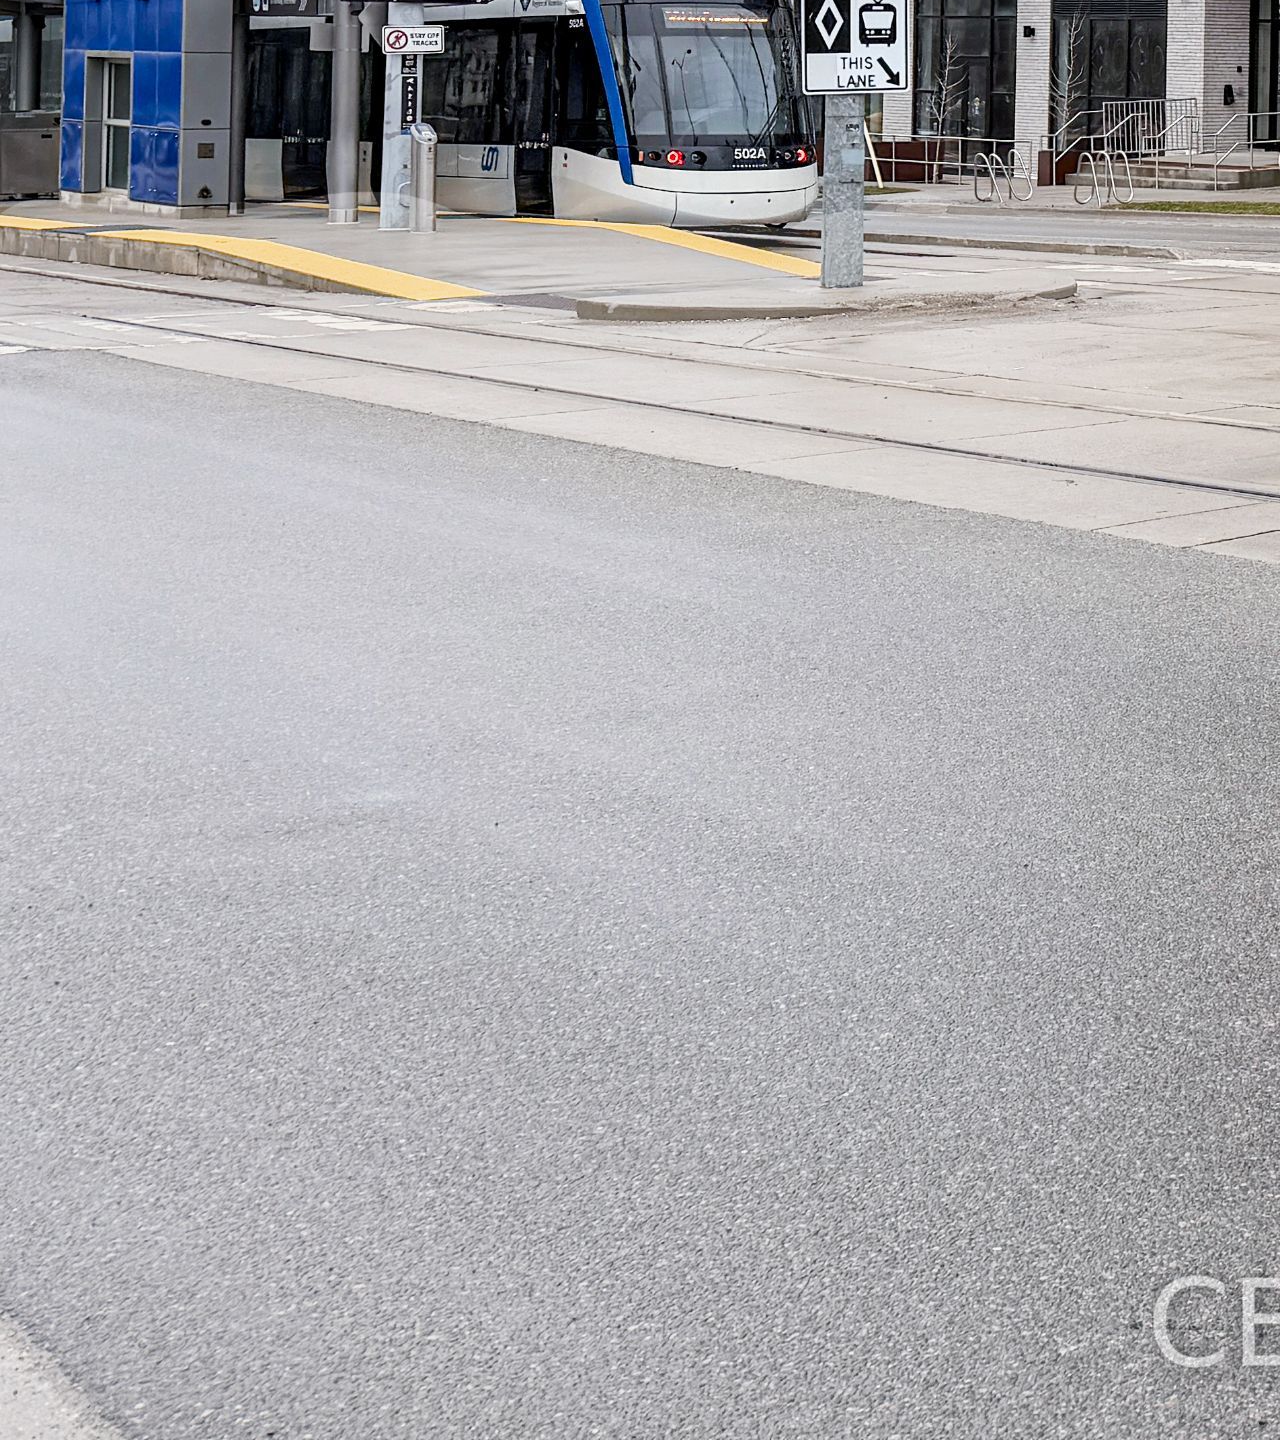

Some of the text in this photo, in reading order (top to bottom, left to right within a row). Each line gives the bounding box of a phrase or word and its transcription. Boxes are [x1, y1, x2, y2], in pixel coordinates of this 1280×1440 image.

[840, 56, 873, 70] THIS
[837, 74, 877, 88] LANE
[734, 148, 767, 160] 502A
